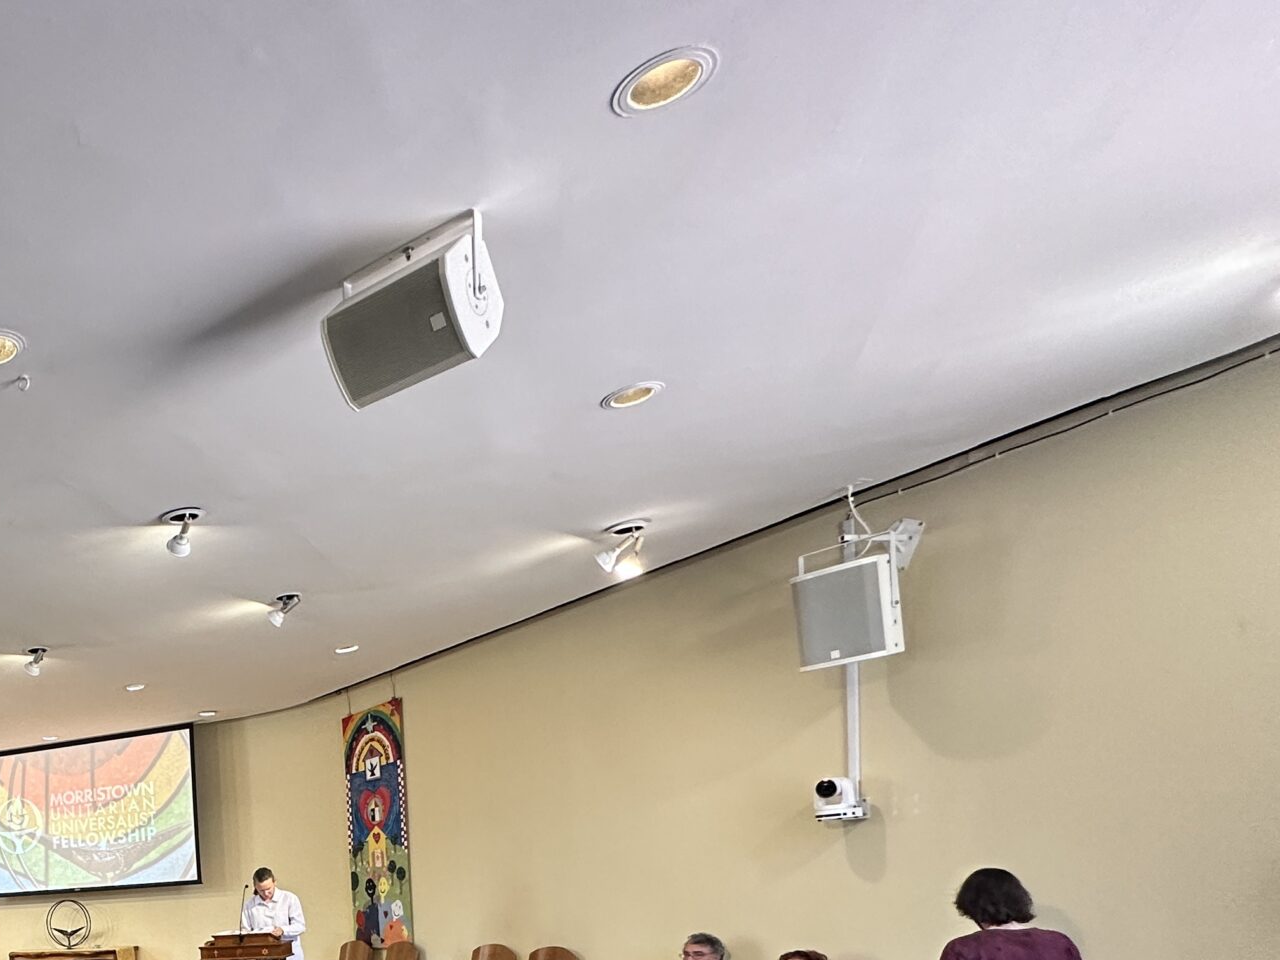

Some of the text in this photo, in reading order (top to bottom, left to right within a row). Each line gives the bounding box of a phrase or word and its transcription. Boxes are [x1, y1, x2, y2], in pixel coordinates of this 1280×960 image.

[51, 782, 153, 806] MORRISTOWN
[51, 796, 155, 821] UNITARIAN
[52, 811, 156, 834] UNIVERSALIST
[53, 827, 157, 848] FELLOWSHIP
